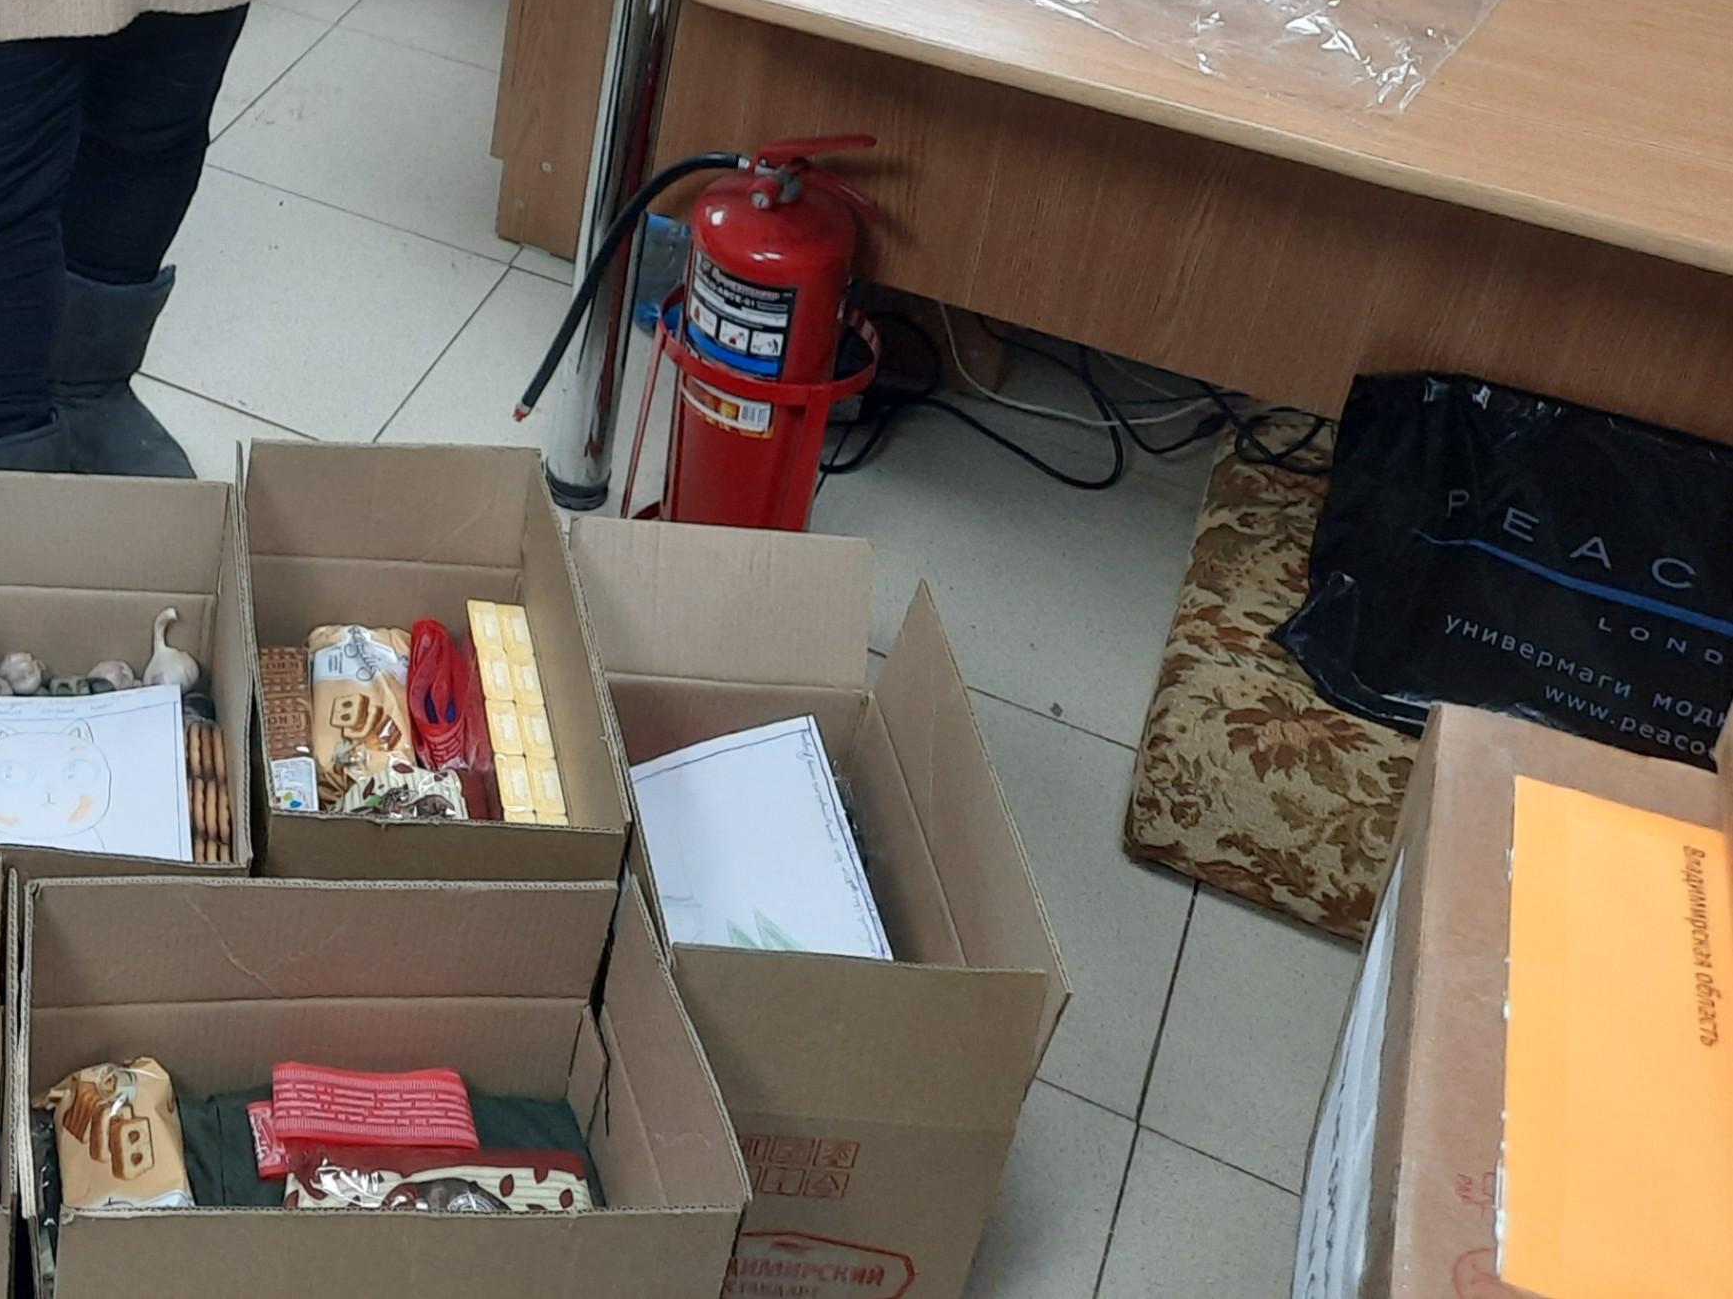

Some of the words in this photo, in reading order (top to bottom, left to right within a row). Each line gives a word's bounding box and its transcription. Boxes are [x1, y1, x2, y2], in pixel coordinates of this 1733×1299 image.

[1445, 488, 1698, 591] PEAC
[1444, 613, 1633, 699] универмаги
[1596, 615, 1725, 667] LOND
[1682, 845, 1714, 967] Владимирская
[1694, 968, 1720, 1048] область
